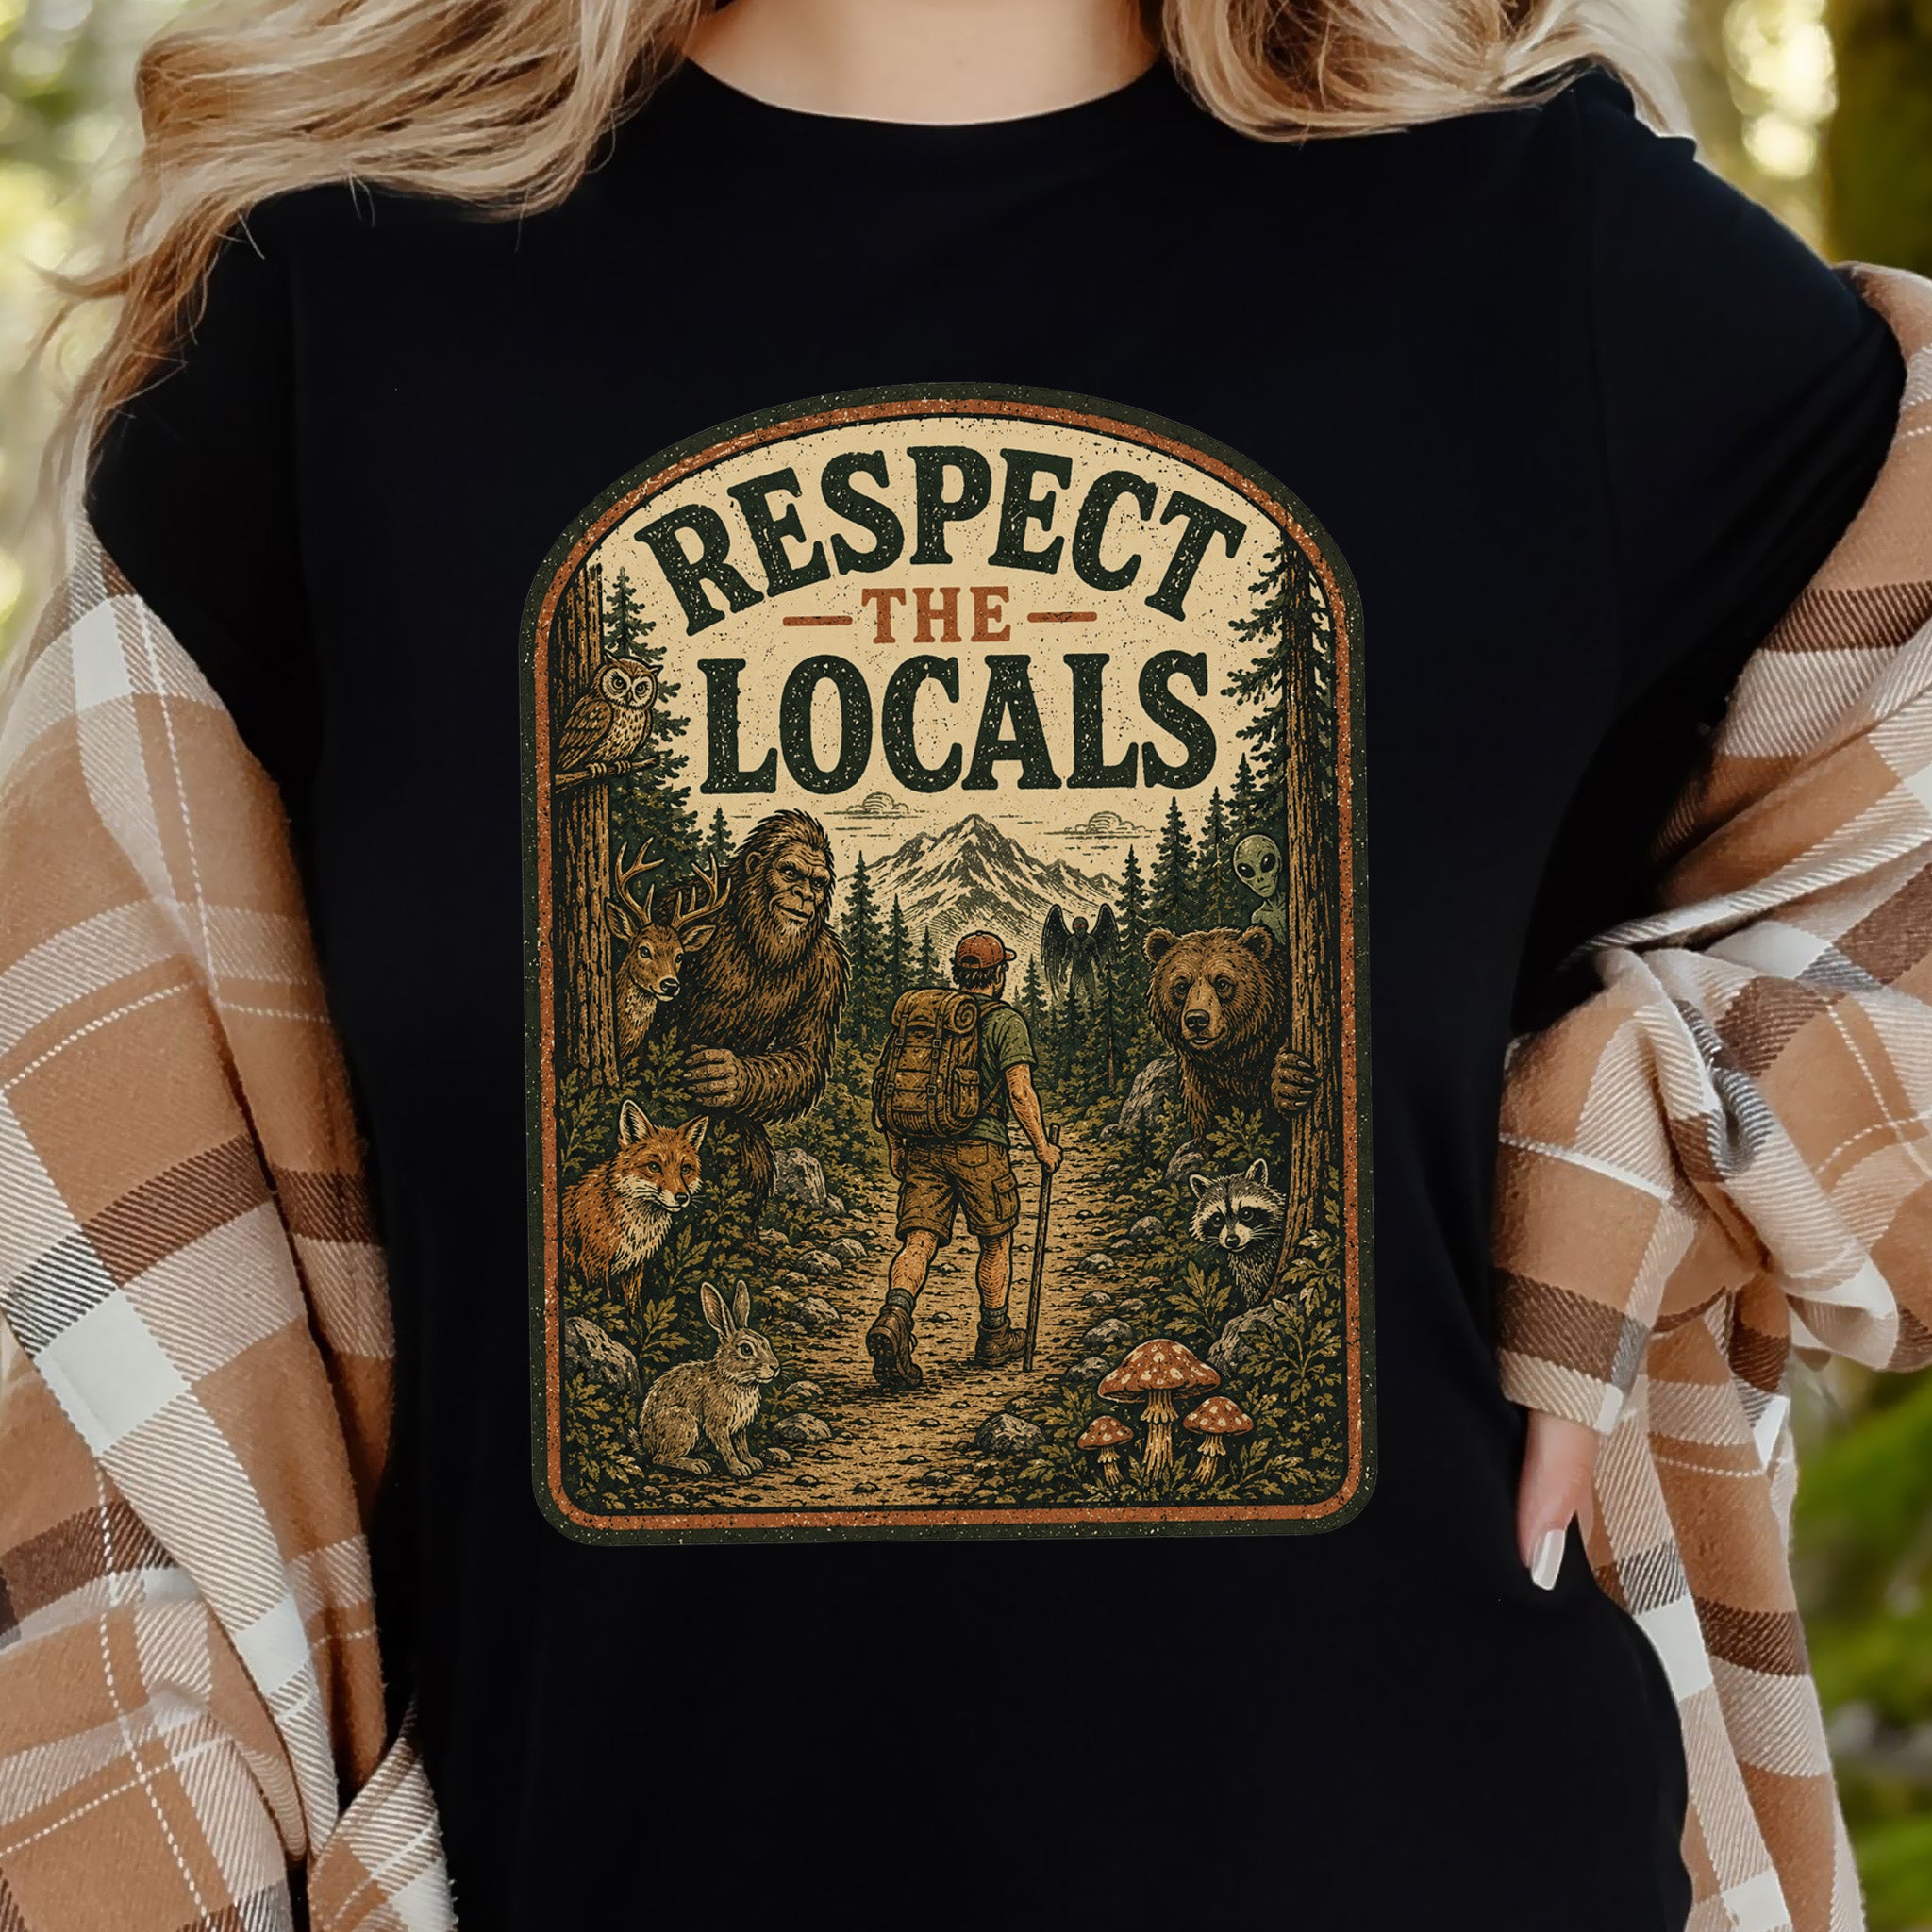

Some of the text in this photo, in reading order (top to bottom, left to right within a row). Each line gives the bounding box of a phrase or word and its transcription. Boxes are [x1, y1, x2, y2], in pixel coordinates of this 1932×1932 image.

[634, 446, 1247, 636] RESPECT
[862, 587, 1010, 643] THE
[698, 651, 1217, 795] LOCALS
